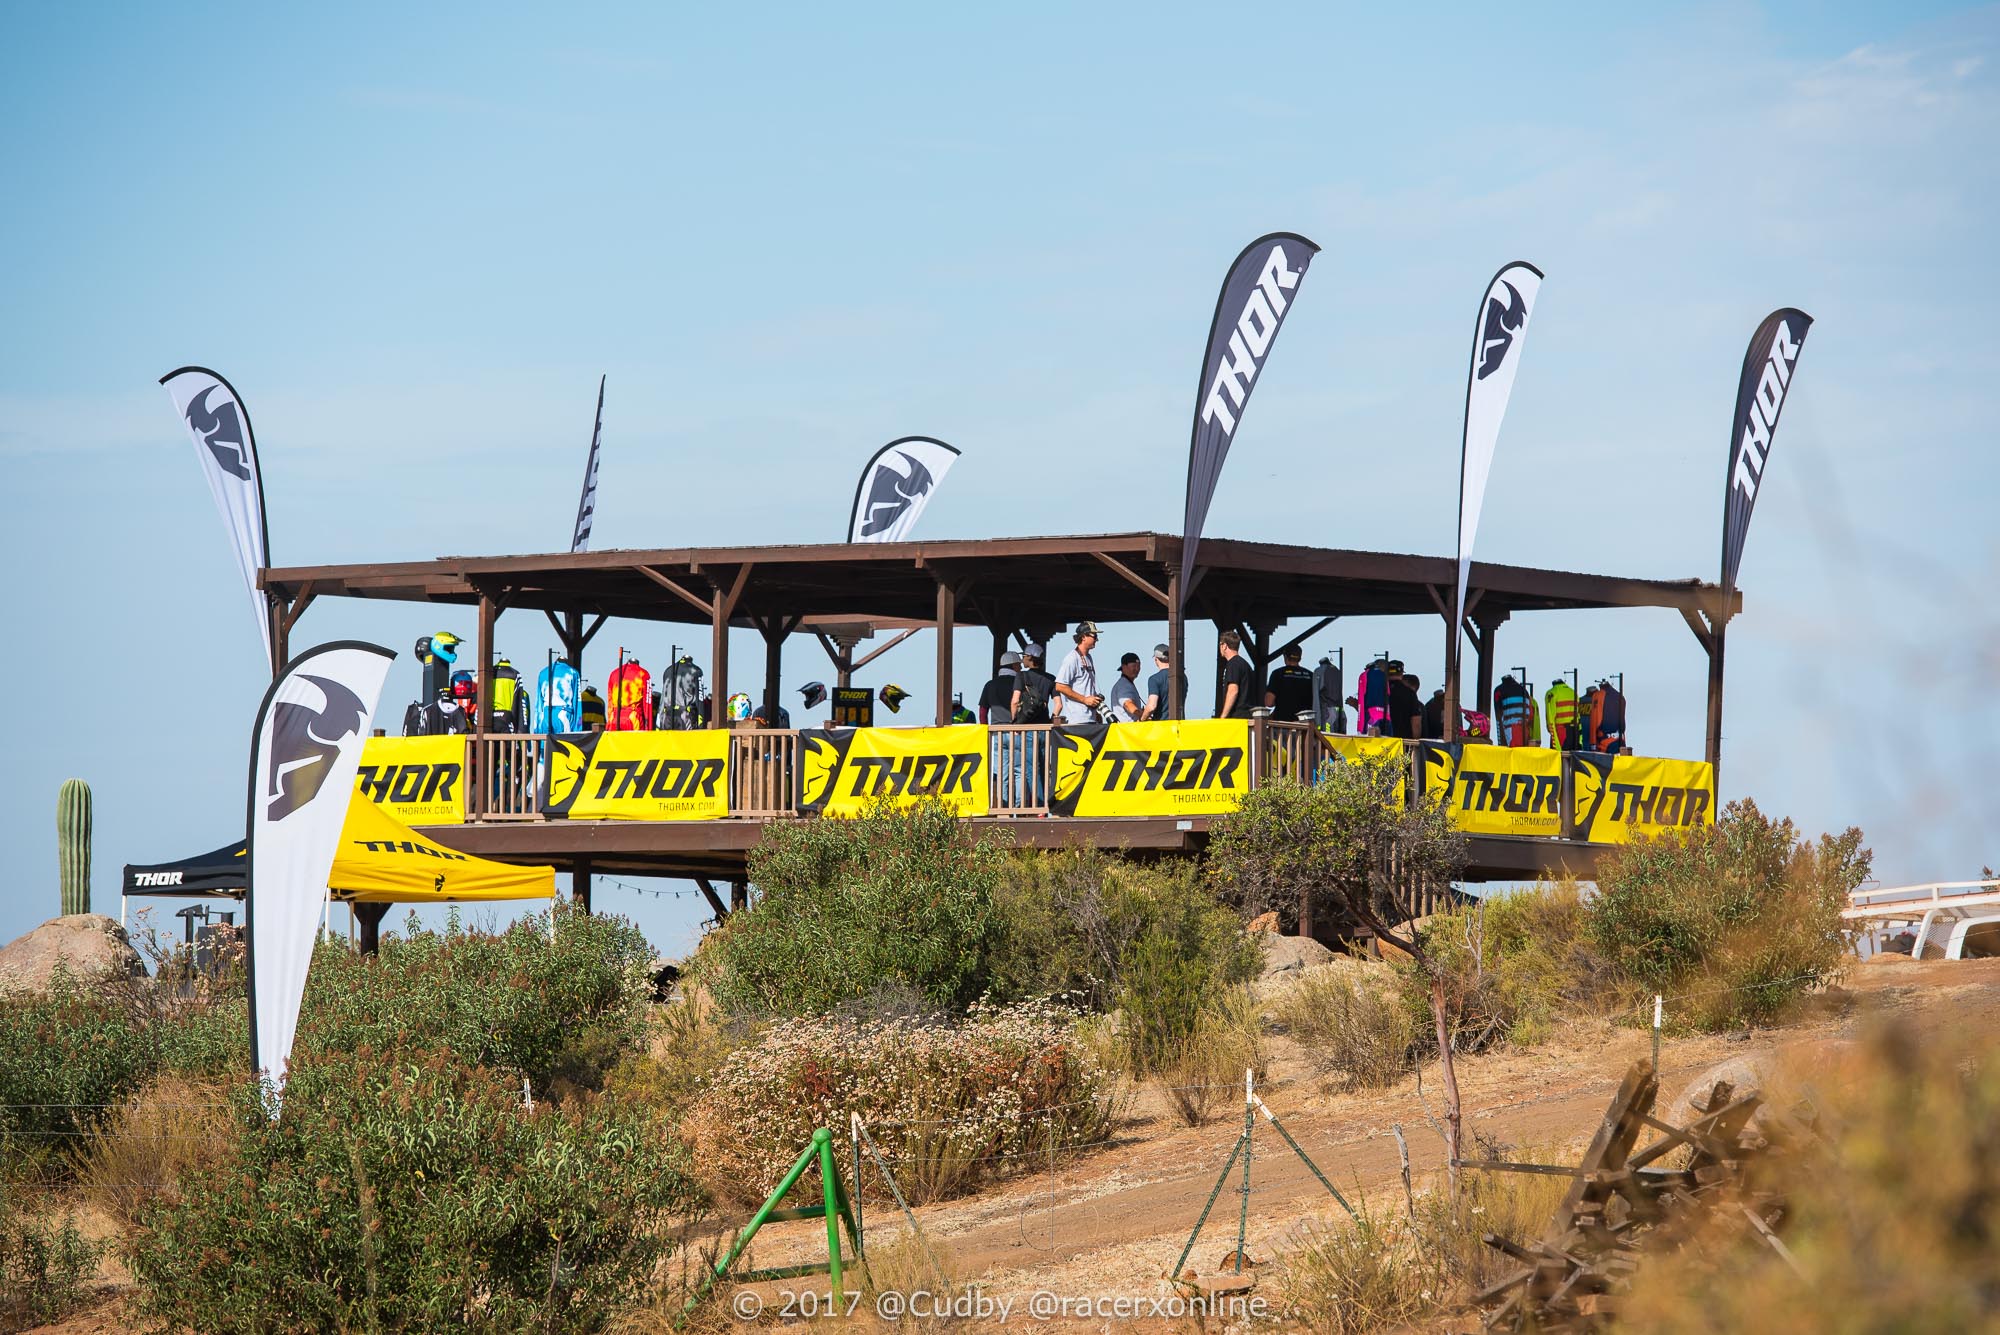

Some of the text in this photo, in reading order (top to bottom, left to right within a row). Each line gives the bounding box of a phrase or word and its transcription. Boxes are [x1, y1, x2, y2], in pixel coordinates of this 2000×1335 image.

[1202, 245, 1300, 436] THOR
[1734, 320, 1799, 501] THOR
[595, 759, 725, 799] THOR
[850, 752, 982, 796] THOR
[1101, 747, 1243, 791] THOR
[397, 806, 453, 815] THORMX.COM
[658, 802, 715, 811] THORMX.COM
[1173, 793, 1235, 803] THORMX.COM
[1459, 771, 1560, 813] THOR
[1610, 783, 1710, 826] THOR
[1510, 816, 1557, 826] THORMX.COM
[354, 841, 469, 861] THOR
[135, 872, 183, 886] THOR
